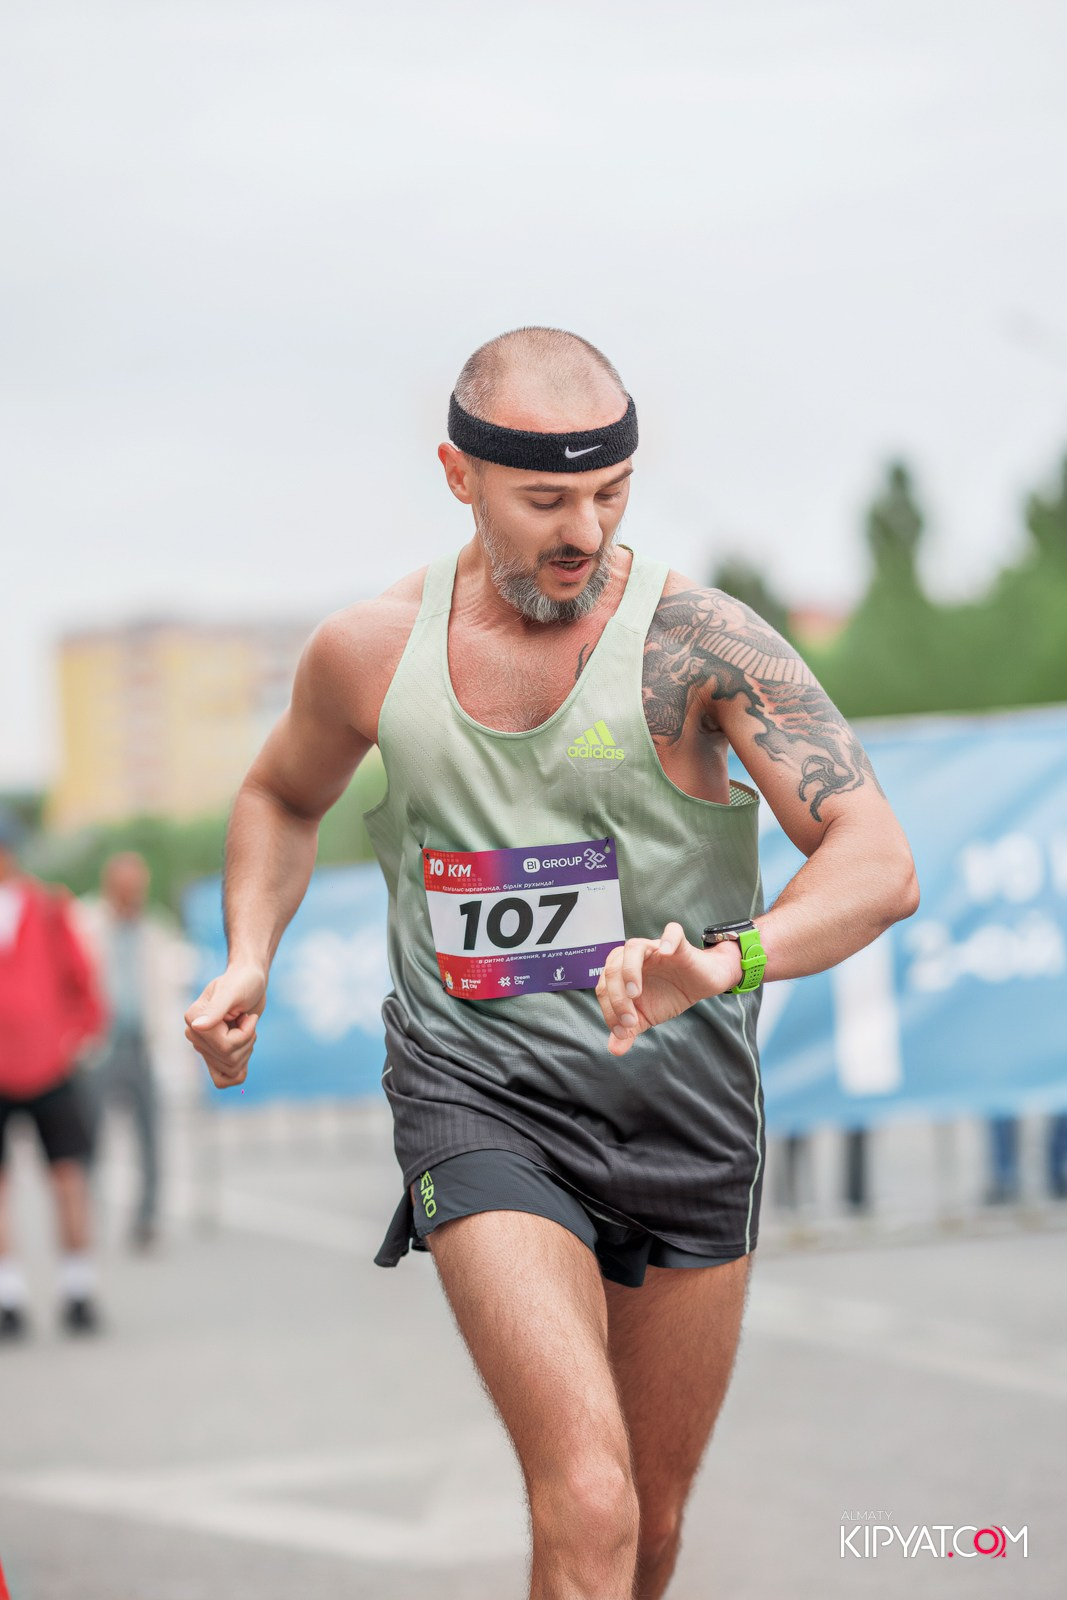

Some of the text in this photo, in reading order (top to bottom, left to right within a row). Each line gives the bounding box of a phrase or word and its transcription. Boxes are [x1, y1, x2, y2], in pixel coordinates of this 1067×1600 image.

[567, 744, 625, 760] adidas
[429, 858, 444, 876] 10
[542, 856, 583, 869] GROUP
[523, 880, 554, 889] рухында!
[459, 891, 580, 950] 107
[484, 957, 505, 965] ритме
[505, 953, 540, 963] движения,
[548, 951, 563, 959] духе
[564, 946, 597, 956] единства!
